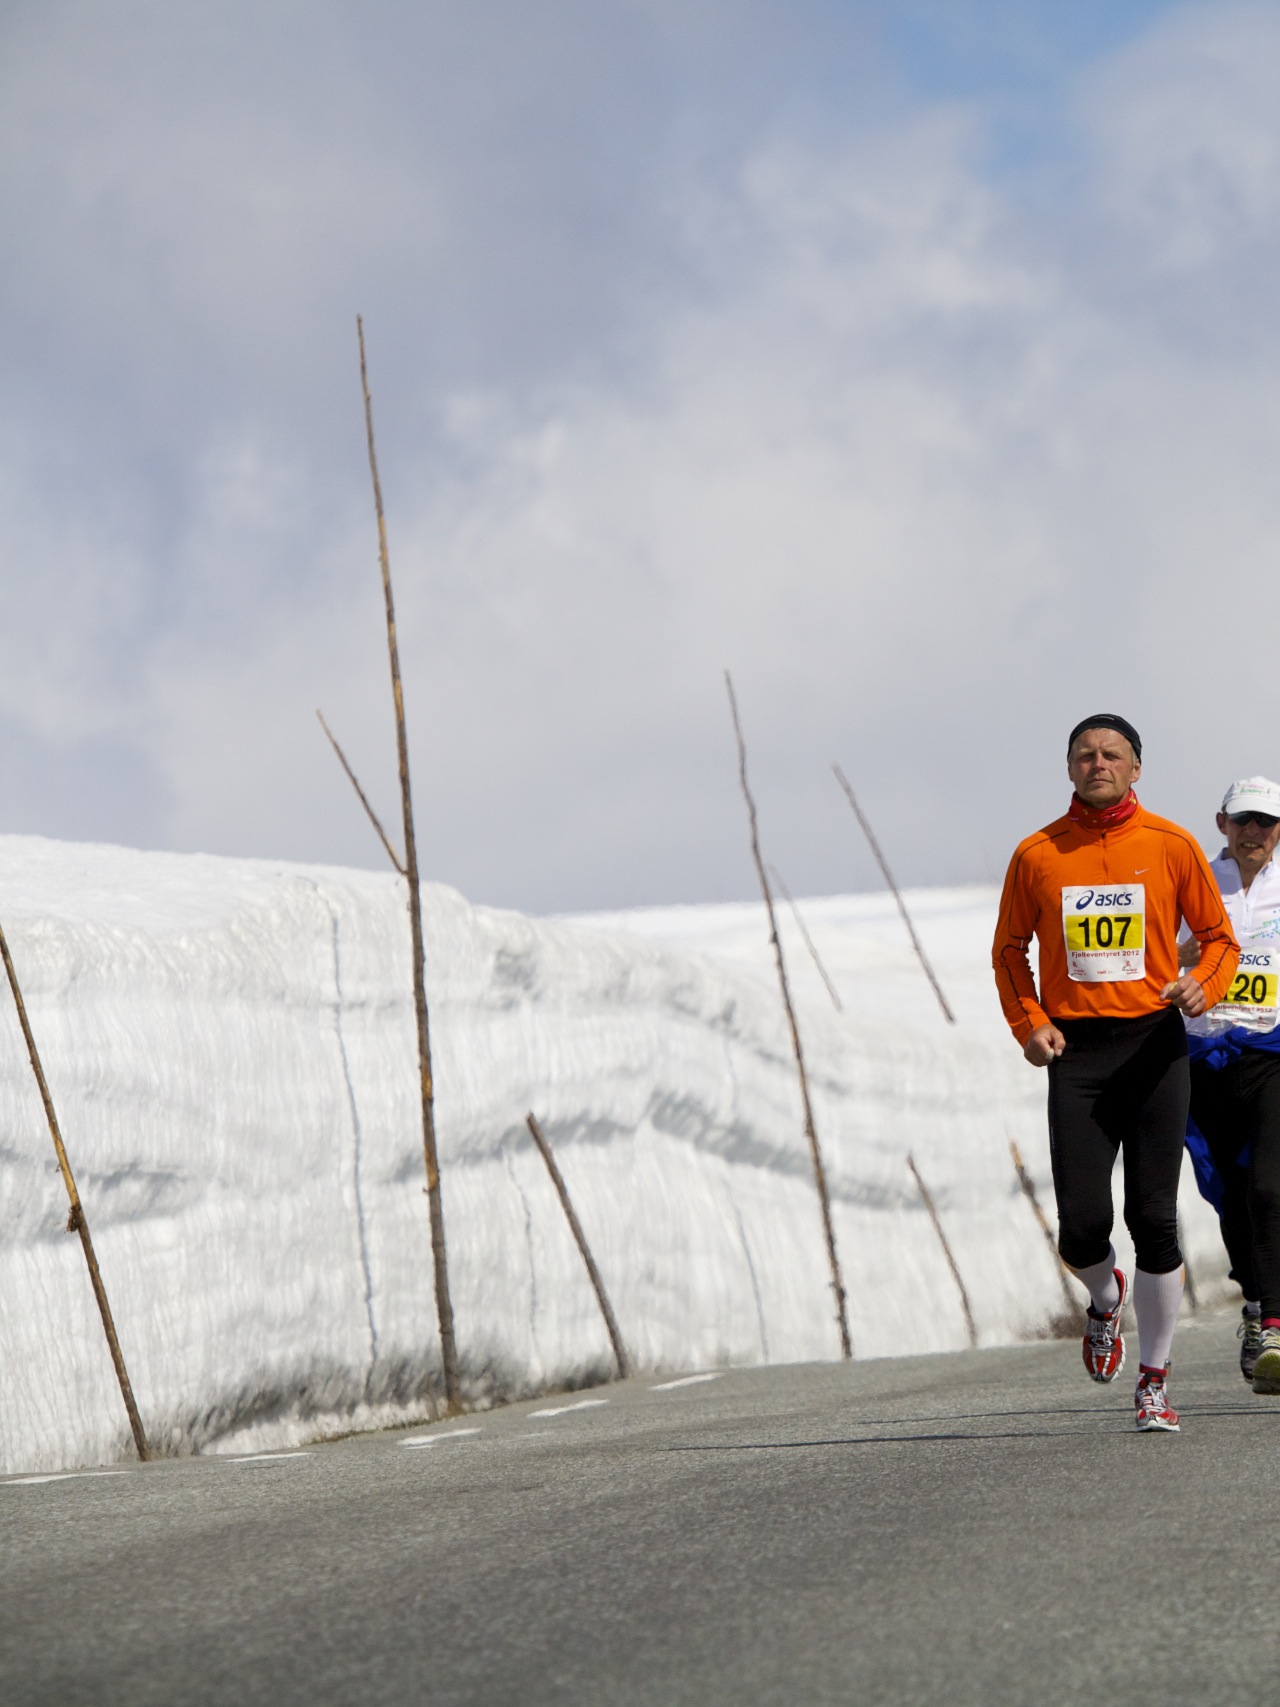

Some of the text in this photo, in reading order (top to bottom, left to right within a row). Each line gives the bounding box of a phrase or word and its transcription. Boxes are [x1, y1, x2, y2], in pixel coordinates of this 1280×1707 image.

[1078, 916, 1132, 948] 107
[1071, 951, 1120, 959] Fjelleventyret
[1224, 973, 1267, 1004] 20
